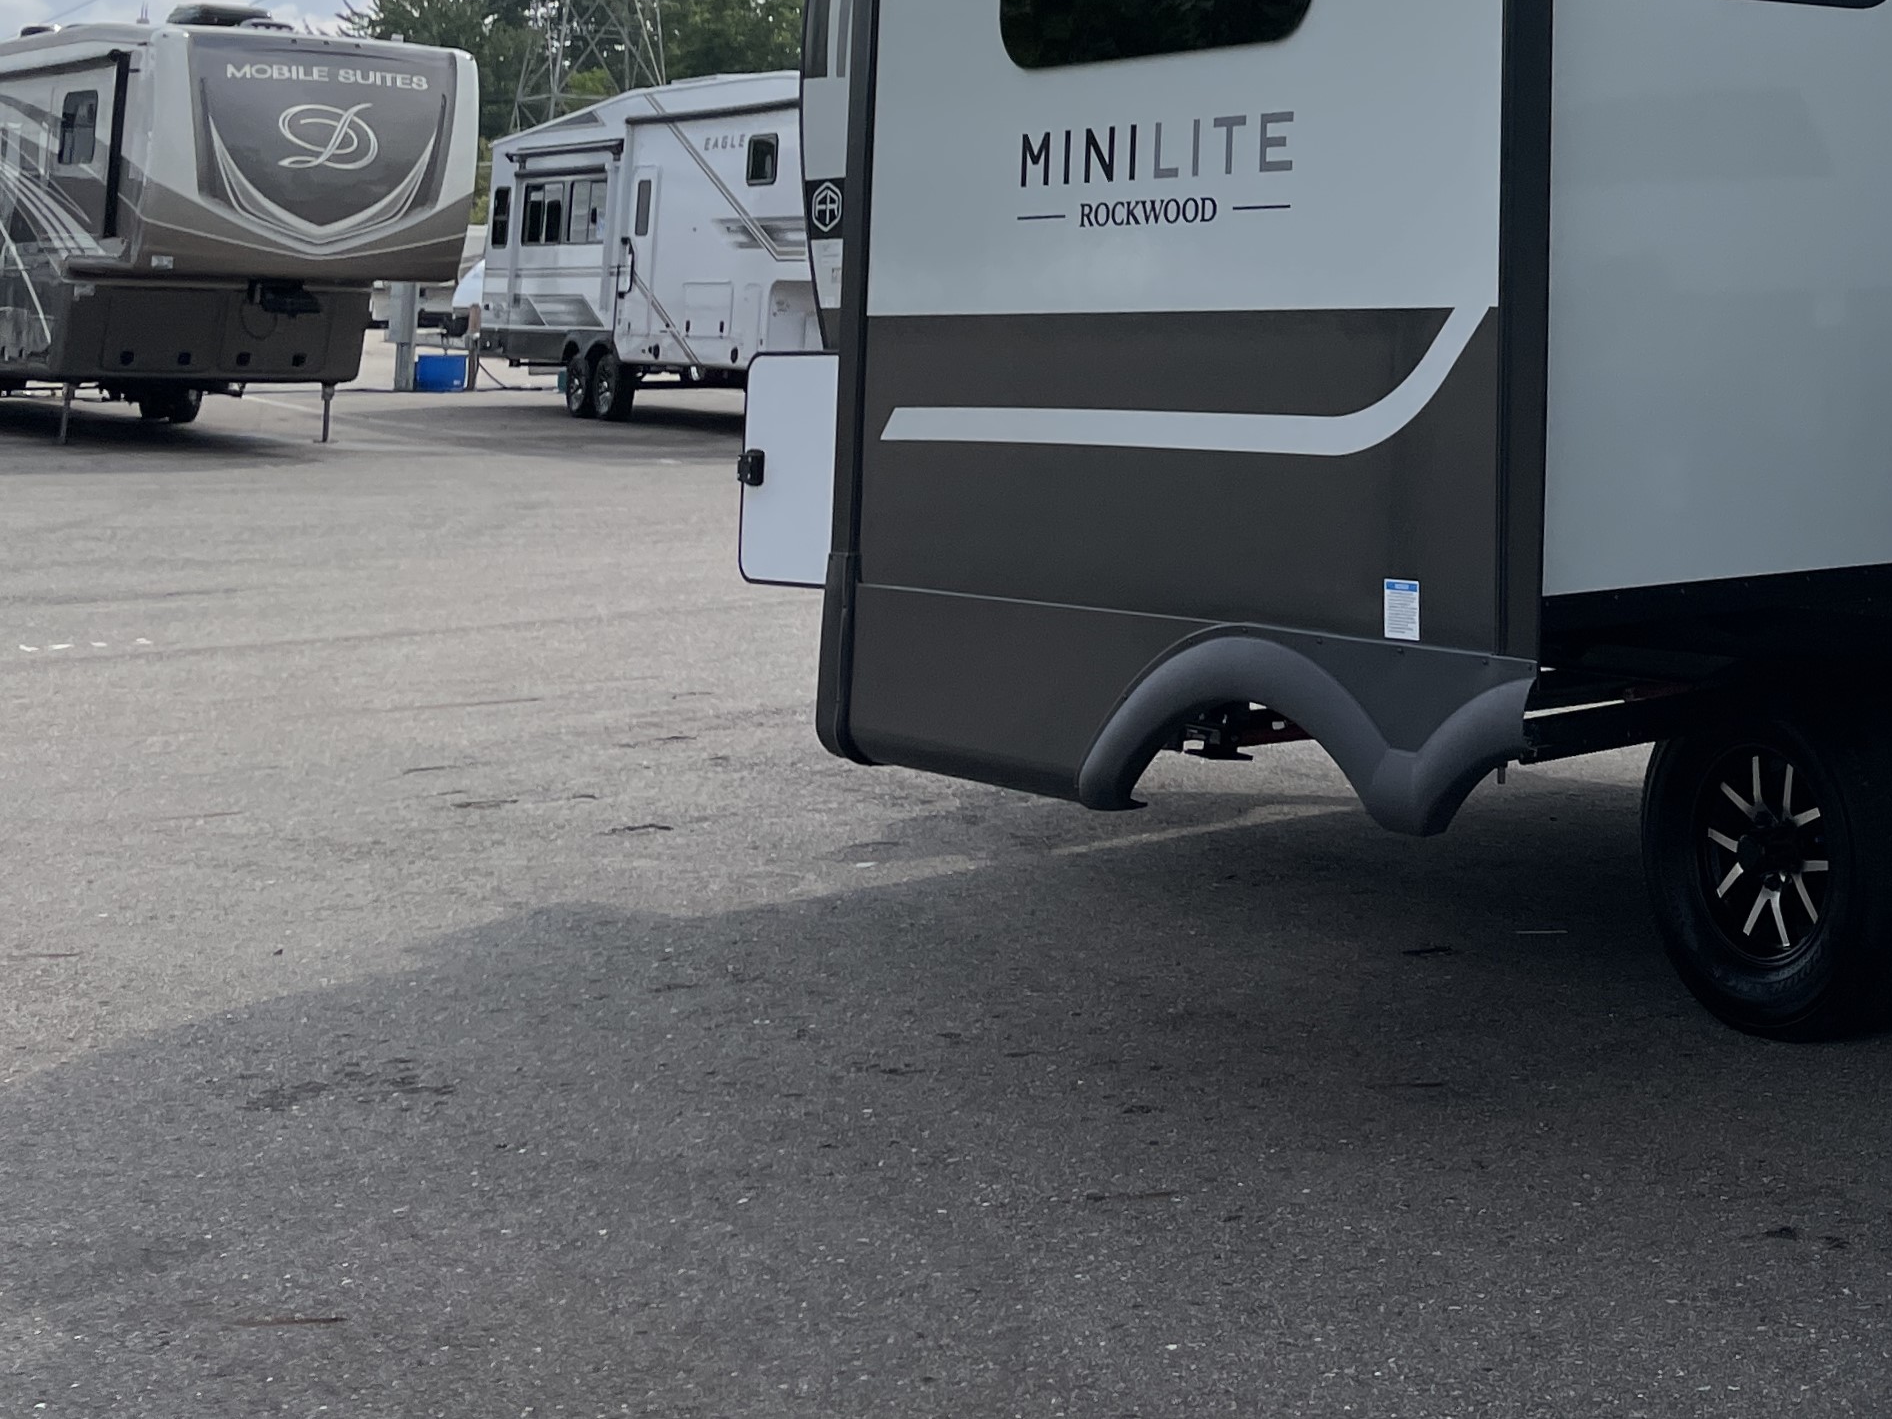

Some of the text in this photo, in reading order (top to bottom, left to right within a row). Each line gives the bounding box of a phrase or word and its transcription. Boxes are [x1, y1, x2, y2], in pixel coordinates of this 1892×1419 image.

[226, 63, 429, 91] MOBILE SUITES
[704, 133, 746, 151] EAGLE
[1020, 111, 1294, 187] MINILITE
[1079, 197, 1218, 228] ROCKWOOD
